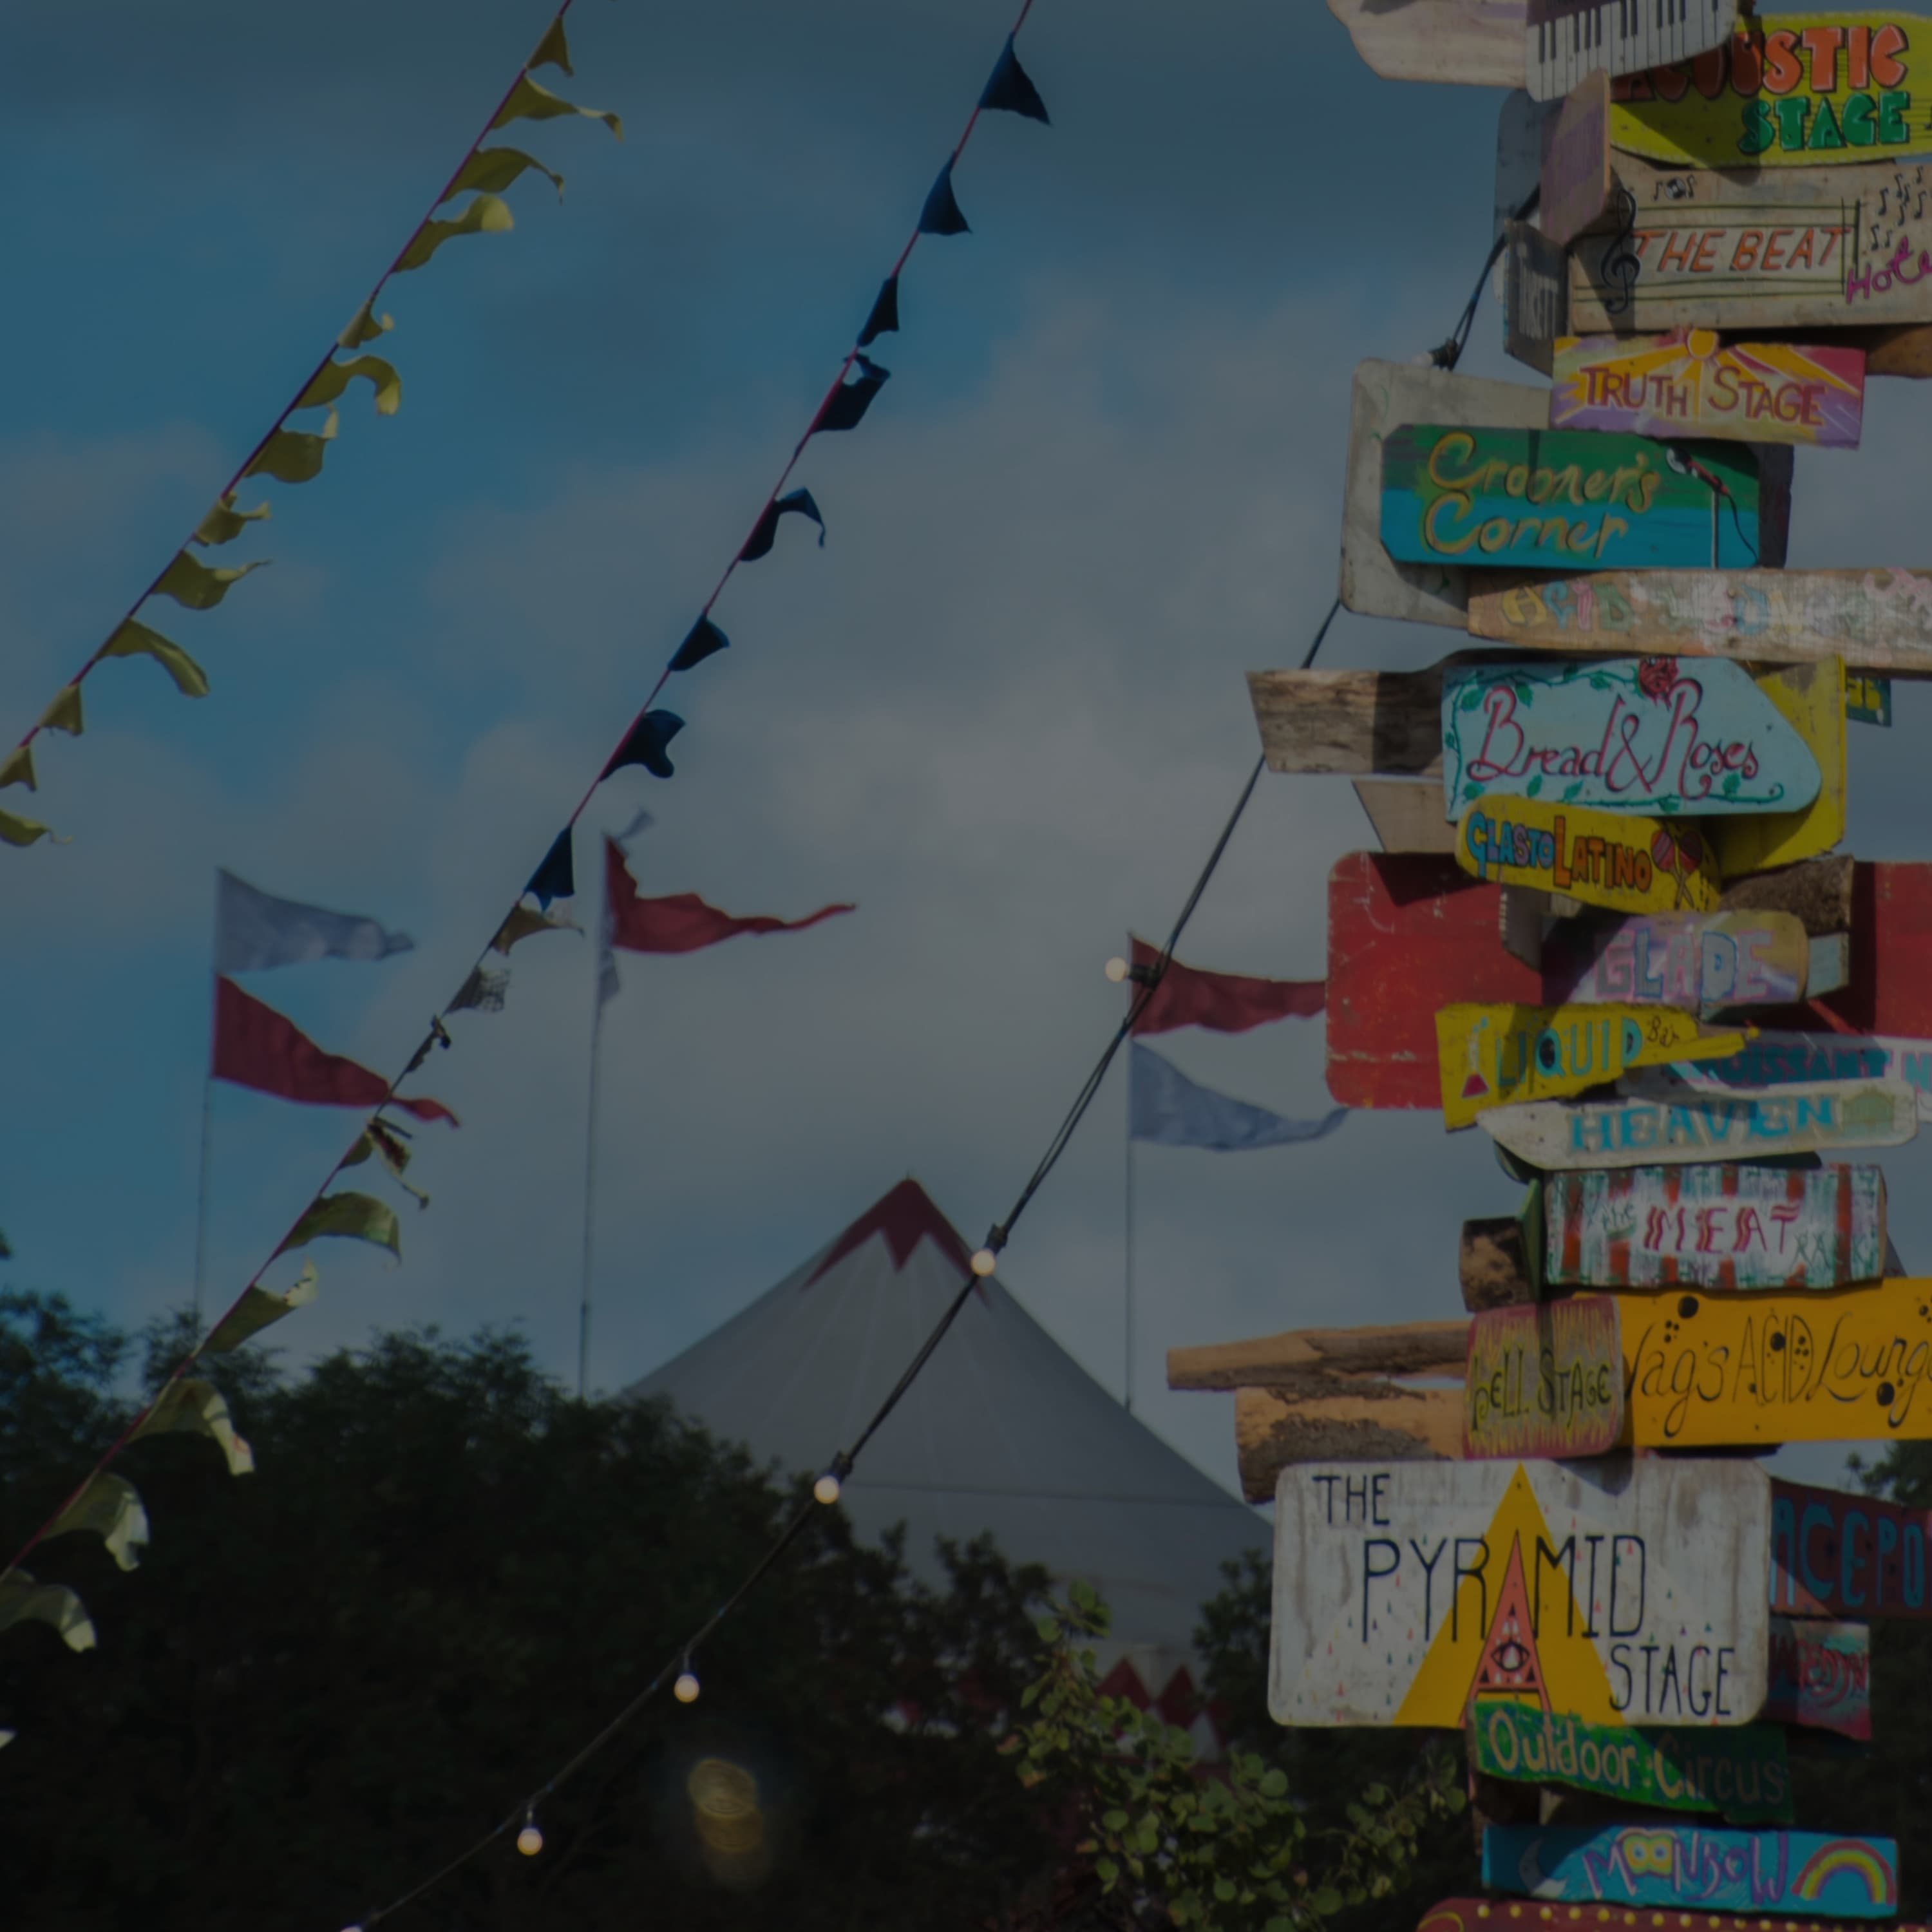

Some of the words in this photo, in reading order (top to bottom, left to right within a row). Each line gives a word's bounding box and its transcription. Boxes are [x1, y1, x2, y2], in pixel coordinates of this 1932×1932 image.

[1738, 91, 1910, 155] STAGE
[1633, 228, 1725, 272] THE
[1730, 226, 1852, 271] BEAT
[1580, 365, 1689, 418] TRUTH
[1708, 364, 1826, 427] STAGE
[1426, 431, 1662, 514] Crooner's
[1424, 490, 1629, 559] Corner
[1466, 685, 1624, 782] Bread
[1607, 714, 1653, 794] &
[1646, 677, 1759, 802] Roses
[1595, 928, 1774, 1001] GLADE
[1495, 1015, 1643, 1088] LIQUID
[1571, 1094, 1841, 1151] HEAVEN
[1643, 1204, 1801, 1255] MEAT
[1732, 1314, 1814, 1407] ACID
[1806, 1312, 1932, 1429] Loung
[1312, 1473, 1391, 1526] THE
[1360, 1530, 1647, 1692] PYRAMID
[1609, 1643, 1735, 1717] STAGE
